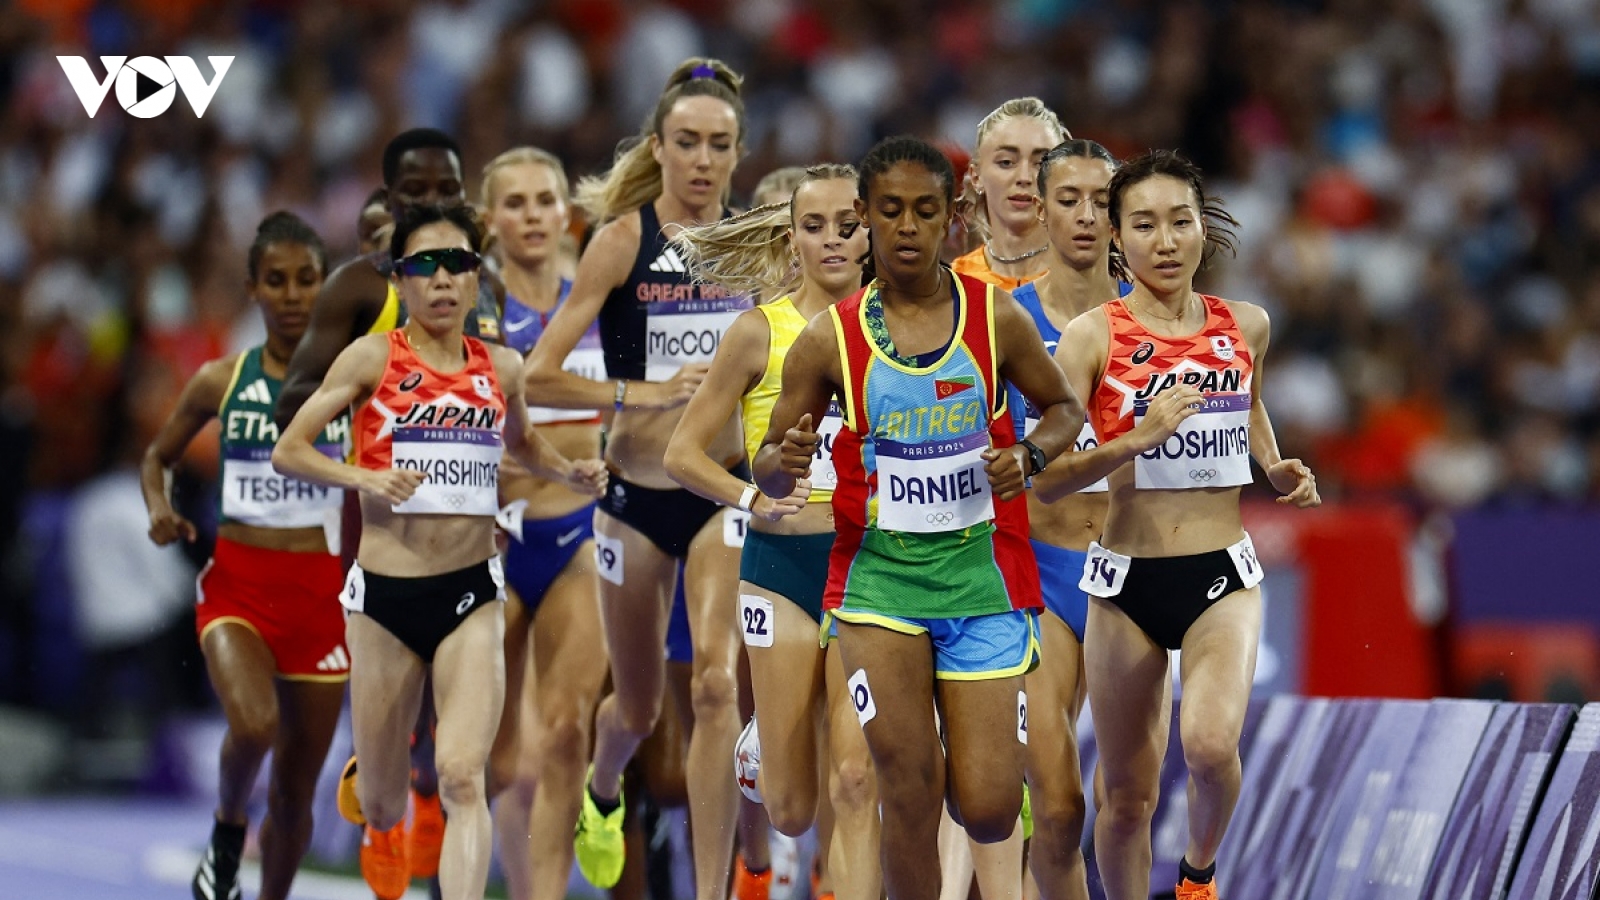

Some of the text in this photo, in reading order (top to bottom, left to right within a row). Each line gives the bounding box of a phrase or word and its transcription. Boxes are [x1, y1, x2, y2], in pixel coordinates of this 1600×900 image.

[636, 283, 693, 302] GREAT
[1135, 370, 1240, 399] JAPAN
[395, 403, 496, 429] JAPAN
[424, 431, 455, 441] PARIS
[903, 442, 965, 456] PARIS 2024
[890, 467, 982, 504] DANIEL
[1091, 556, 1117, 588] 14
[743, 606, 768, 635] 22
[851, 684, 868, 713] 0
